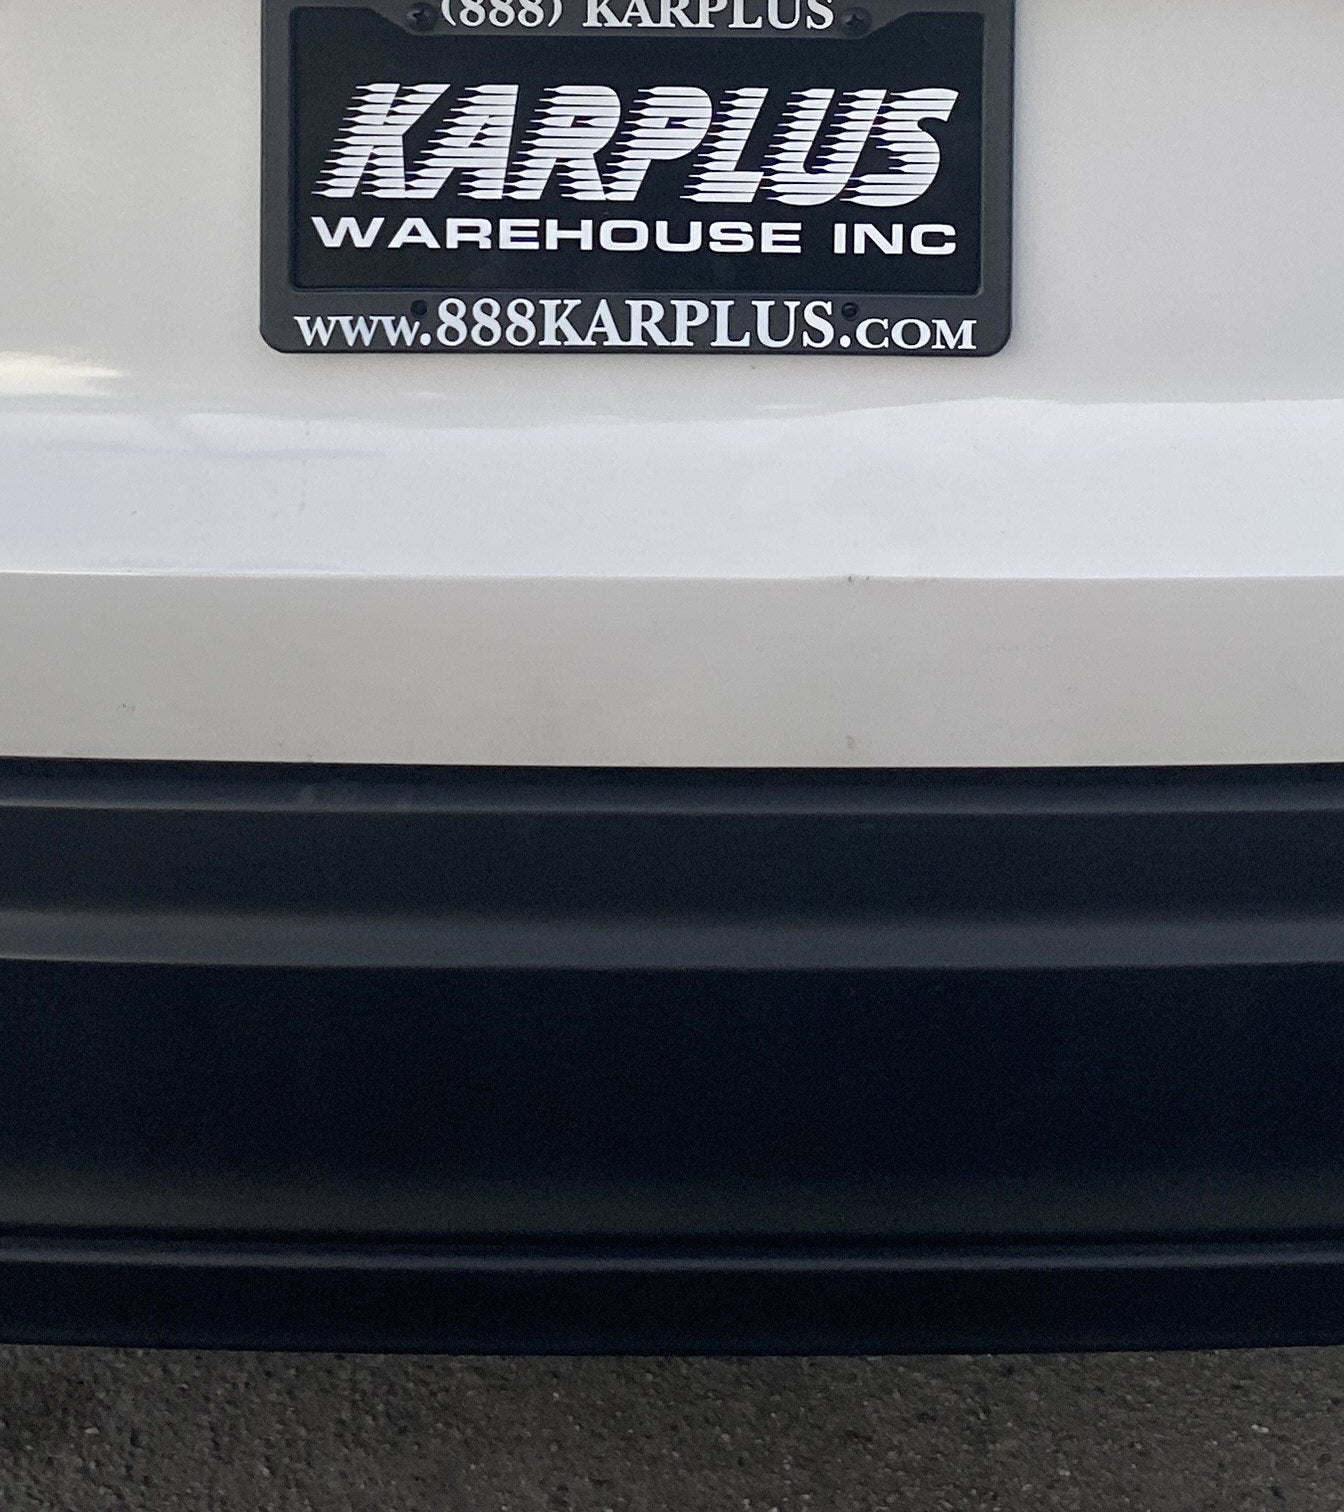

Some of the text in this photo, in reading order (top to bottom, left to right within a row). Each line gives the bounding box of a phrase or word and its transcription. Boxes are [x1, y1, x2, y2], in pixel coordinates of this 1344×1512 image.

[310, 82, 960, 209] KARPLUS
[311, 216, 957, 256] WAREHOUSE INC
